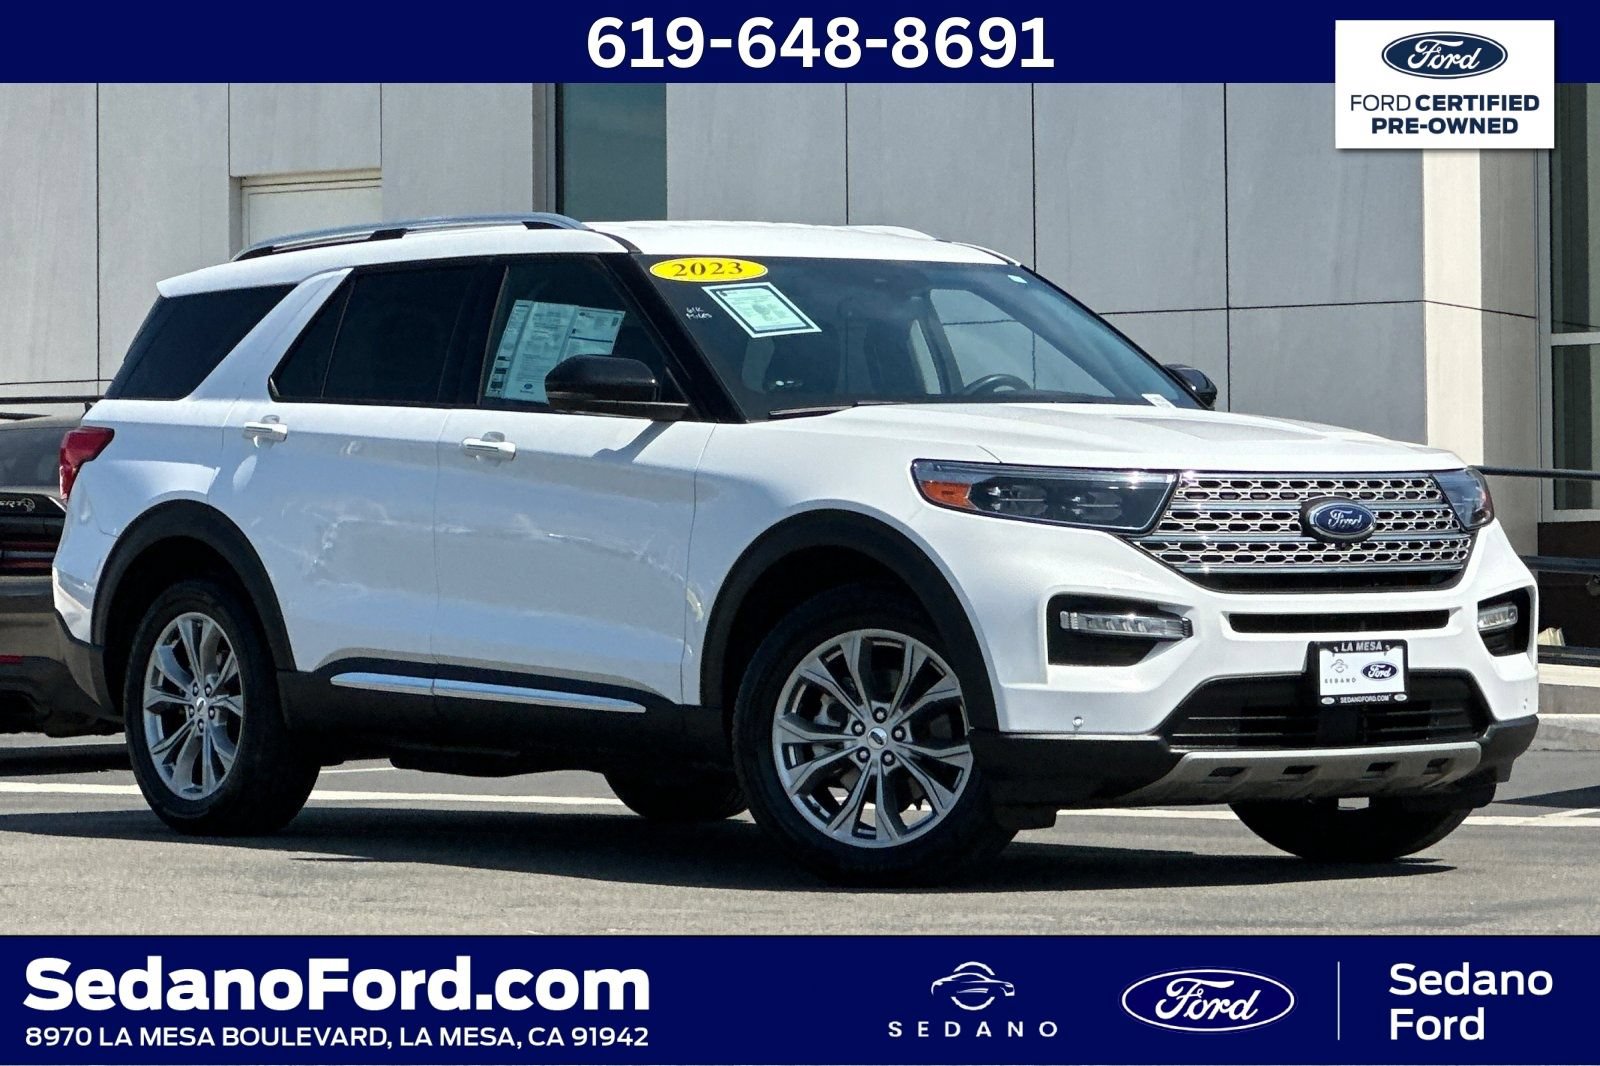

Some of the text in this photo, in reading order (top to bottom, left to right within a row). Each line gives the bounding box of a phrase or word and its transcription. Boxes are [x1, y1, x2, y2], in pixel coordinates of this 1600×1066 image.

[672, 262, 743, 277] 2023
[1328, 509, 1362, 528] Ford
[1341, 641, 1382, 652] LA MESA
[1367, 664, 1391, 678] Ford
[1340, 694, 1390, 704] SEDANOFORD.COM
